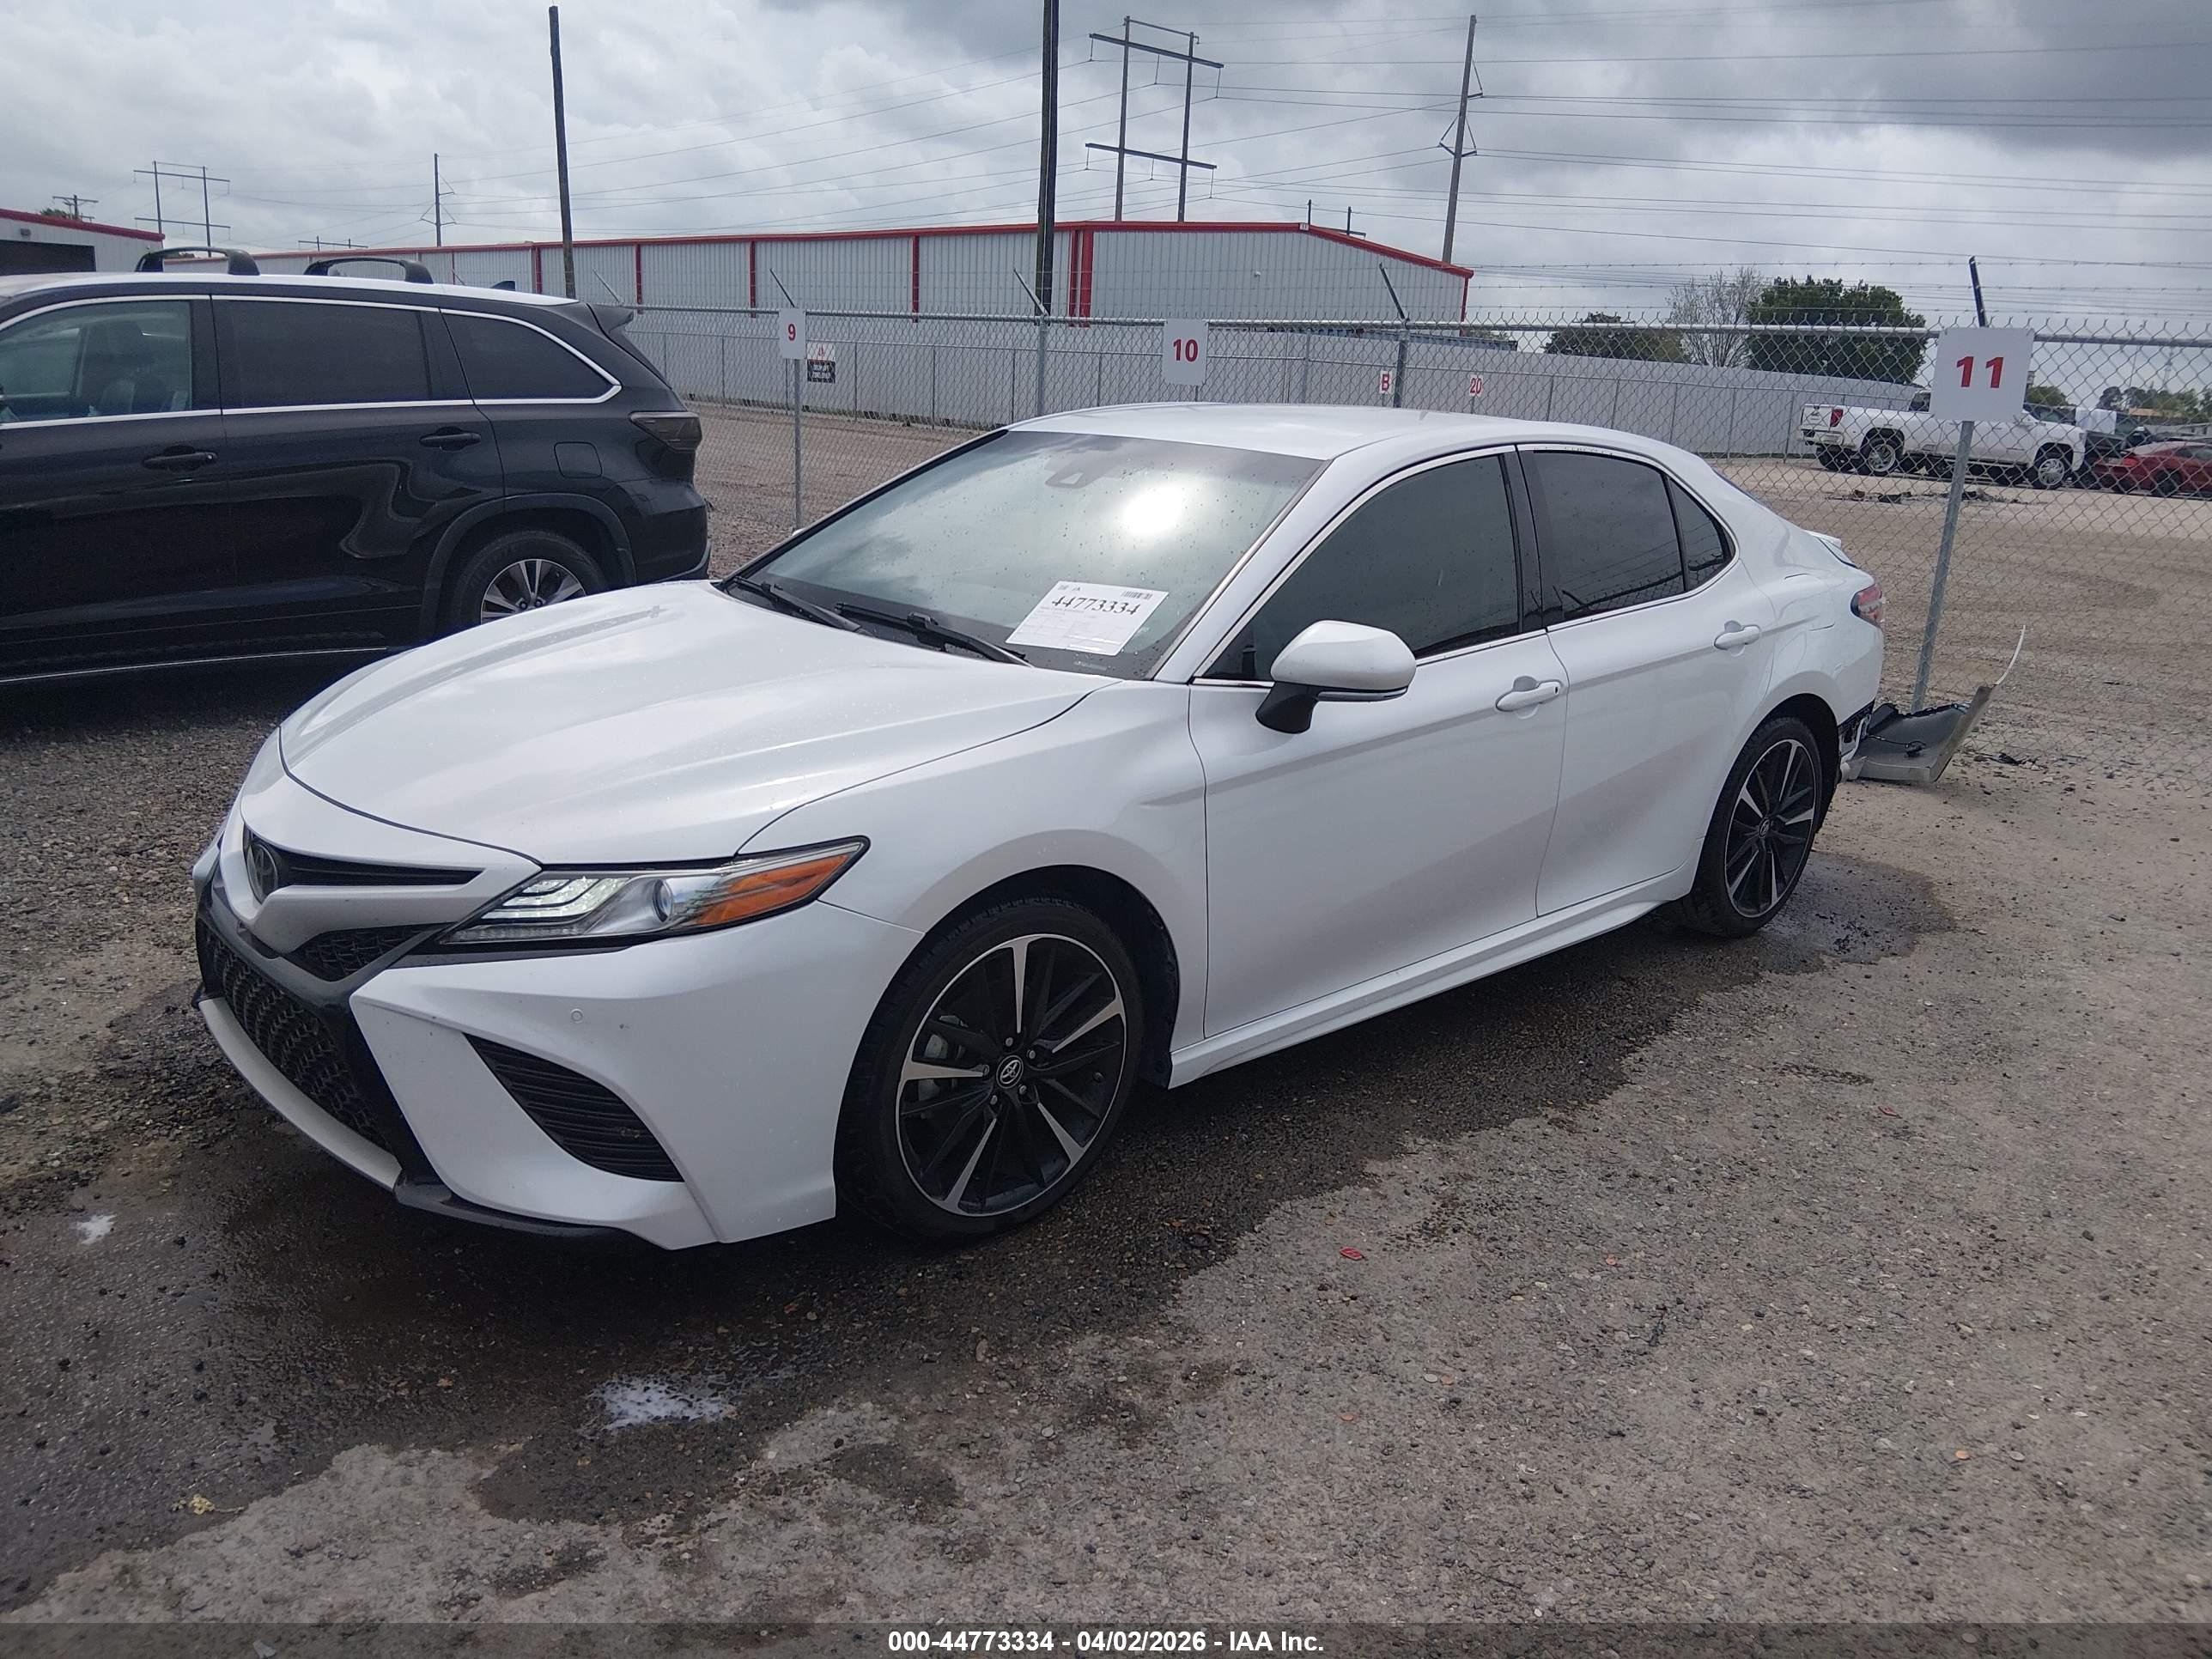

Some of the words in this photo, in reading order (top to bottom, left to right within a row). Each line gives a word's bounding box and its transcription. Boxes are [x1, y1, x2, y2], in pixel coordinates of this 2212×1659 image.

[787, 324, 796, 341] 9
[1173, 339, 1199, 362] 10
[1956, 356, 2004, 389] 11
[1382, 374, 1390, 392] B
[1470, 378, 1482, 394] 20
[1052, 595, 1140, 616] 44773334
